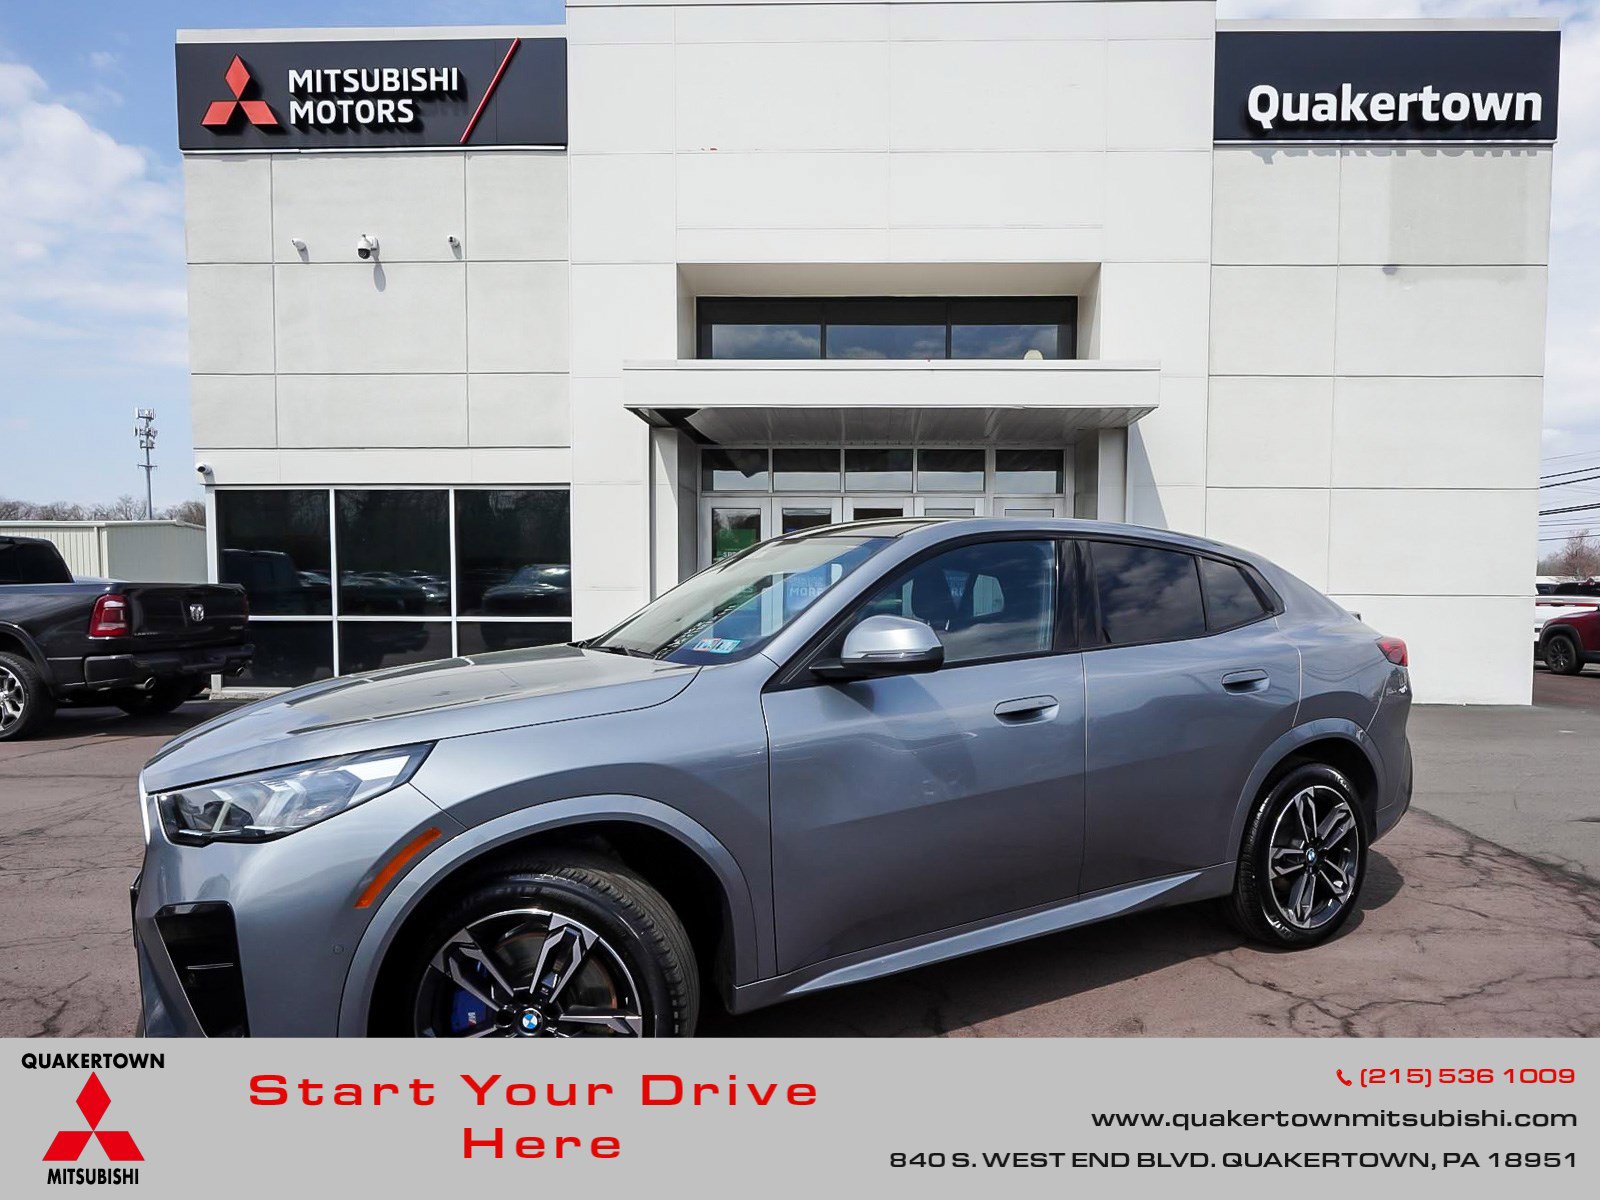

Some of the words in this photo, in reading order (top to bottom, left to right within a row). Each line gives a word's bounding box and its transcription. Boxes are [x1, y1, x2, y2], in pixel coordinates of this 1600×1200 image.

[288, 67, 458, 93] MITSUBISHI
[289, 99, 414, 125] MOTORS
[1247, 83, 1542, 129] Quakertown
